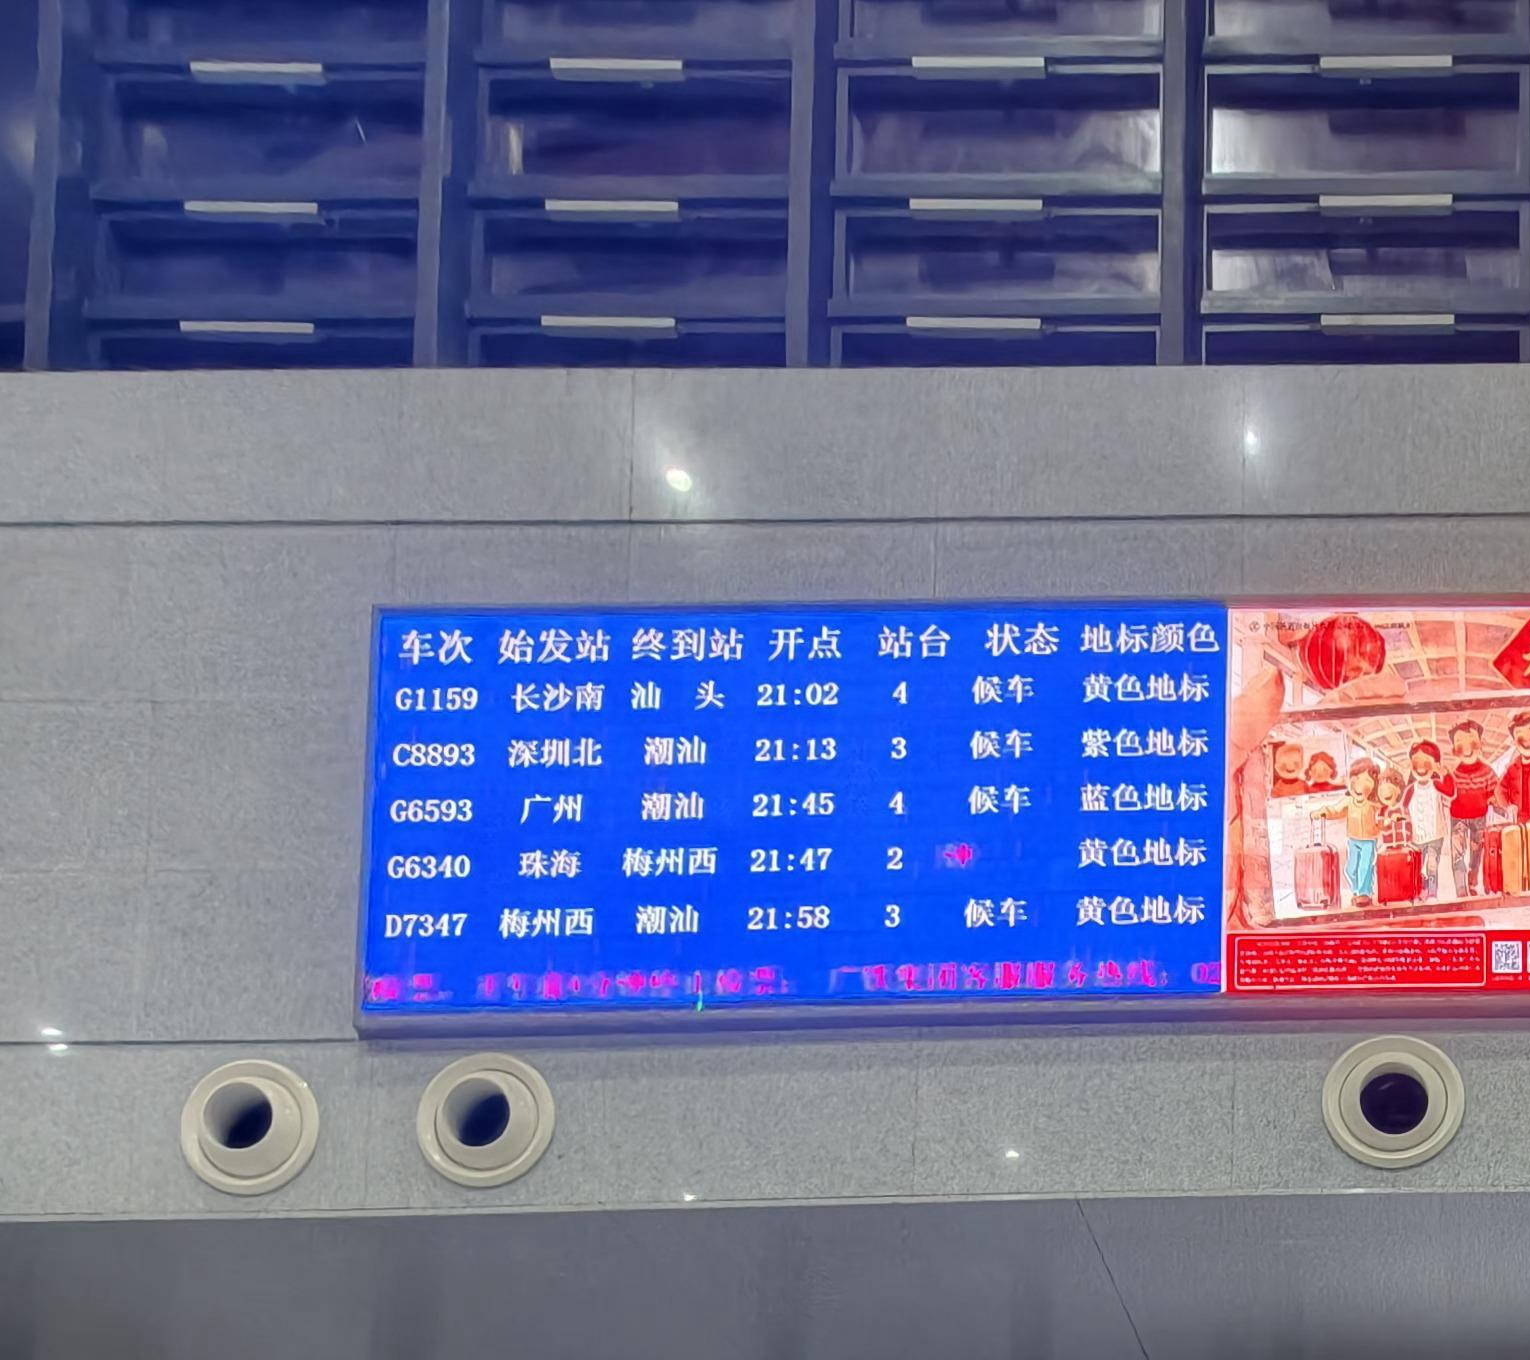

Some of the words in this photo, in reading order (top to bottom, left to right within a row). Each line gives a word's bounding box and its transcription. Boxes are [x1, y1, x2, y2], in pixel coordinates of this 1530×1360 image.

[399, 630, 472, 664] 车次
[499, 629, 610, 663] 始发站
[632, 628, 743, 661] 终到站
[769, 626, 841, 660] 开点
[879, 624, 950, 658] 站台
[985, 622, 1059, 656] 状态
[1080, 623, 1220, 653] 地标颜色
[396, 688, 478, 711] G1159
[512, 682, 605, 712] 长沙南
[631, 680, 724, 709] 汕头
[757, 683, 839, 705] 21:02
[893, 682, 907, 704] 4
[972, 675, 1033, 704] 候车
[1083, 673, 1209, 702] 黄色地标
[393, 743, 475, 766] C8893
[508, 738, 602, 767] 深圳北
[644, 736, 706, 765] 潮汕
[755, 738, 836, 761] 21:13
[891, 737, 907, 759] 3
[970, 729, 1032, 759] 候车
[1082, 728, 1208, 757] 紫色地标
[390, 799, 472, 822] G6593
[521, 794, 582, 823] 广州
[642, 792, 704, 820] 潮汕
[753, 793, 834, 816] 21:45
[889, 792, 903, 814] 4
[968, 784, 1030, 814] 候车
[1081, 783, 1207, 811] 蓝色地标
[387, 855, 470, 878] G6340
[519, 849, 580, 878] 珠海
[622, 848, 717, 876] 梅州西
[751, 848, 832, 872] 21:47
[887, 847, 902, 869] 2
[1079, 837, 1206, 867] 黄色地标
[385, 914, 467, 937] D7347
[499, 908, 593, 938] 梅州西
[636, 905, 698, 934] 潮汕
[748, 906, 830, 930] 21:58
[885, 905, 900, 927] 3
[964, 898, 1027, 928] 候车
[1077, 895, 1204, 925] 黄色地标
